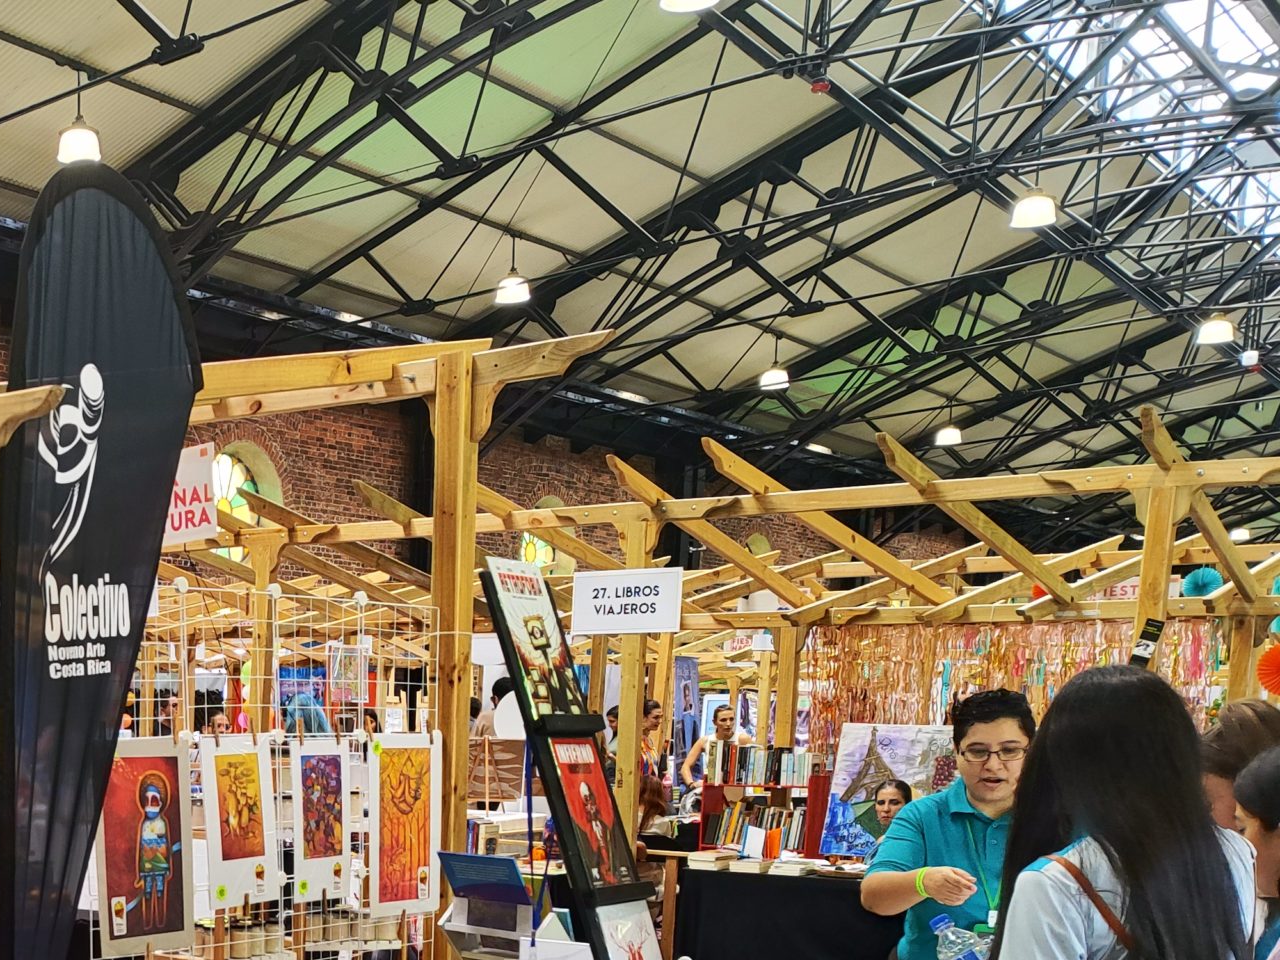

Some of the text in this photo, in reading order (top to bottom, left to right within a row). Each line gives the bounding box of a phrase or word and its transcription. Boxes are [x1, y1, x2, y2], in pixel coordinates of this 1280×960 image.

[592, 585, 660, 599] 27. LIBROS
[44, 570, 131, 643] Colectivo
[594, 602, 657, 615] VIAJEROS
[86, 642, 106, 658] Arte
[49, 659, 112, 679] Costa Rica
